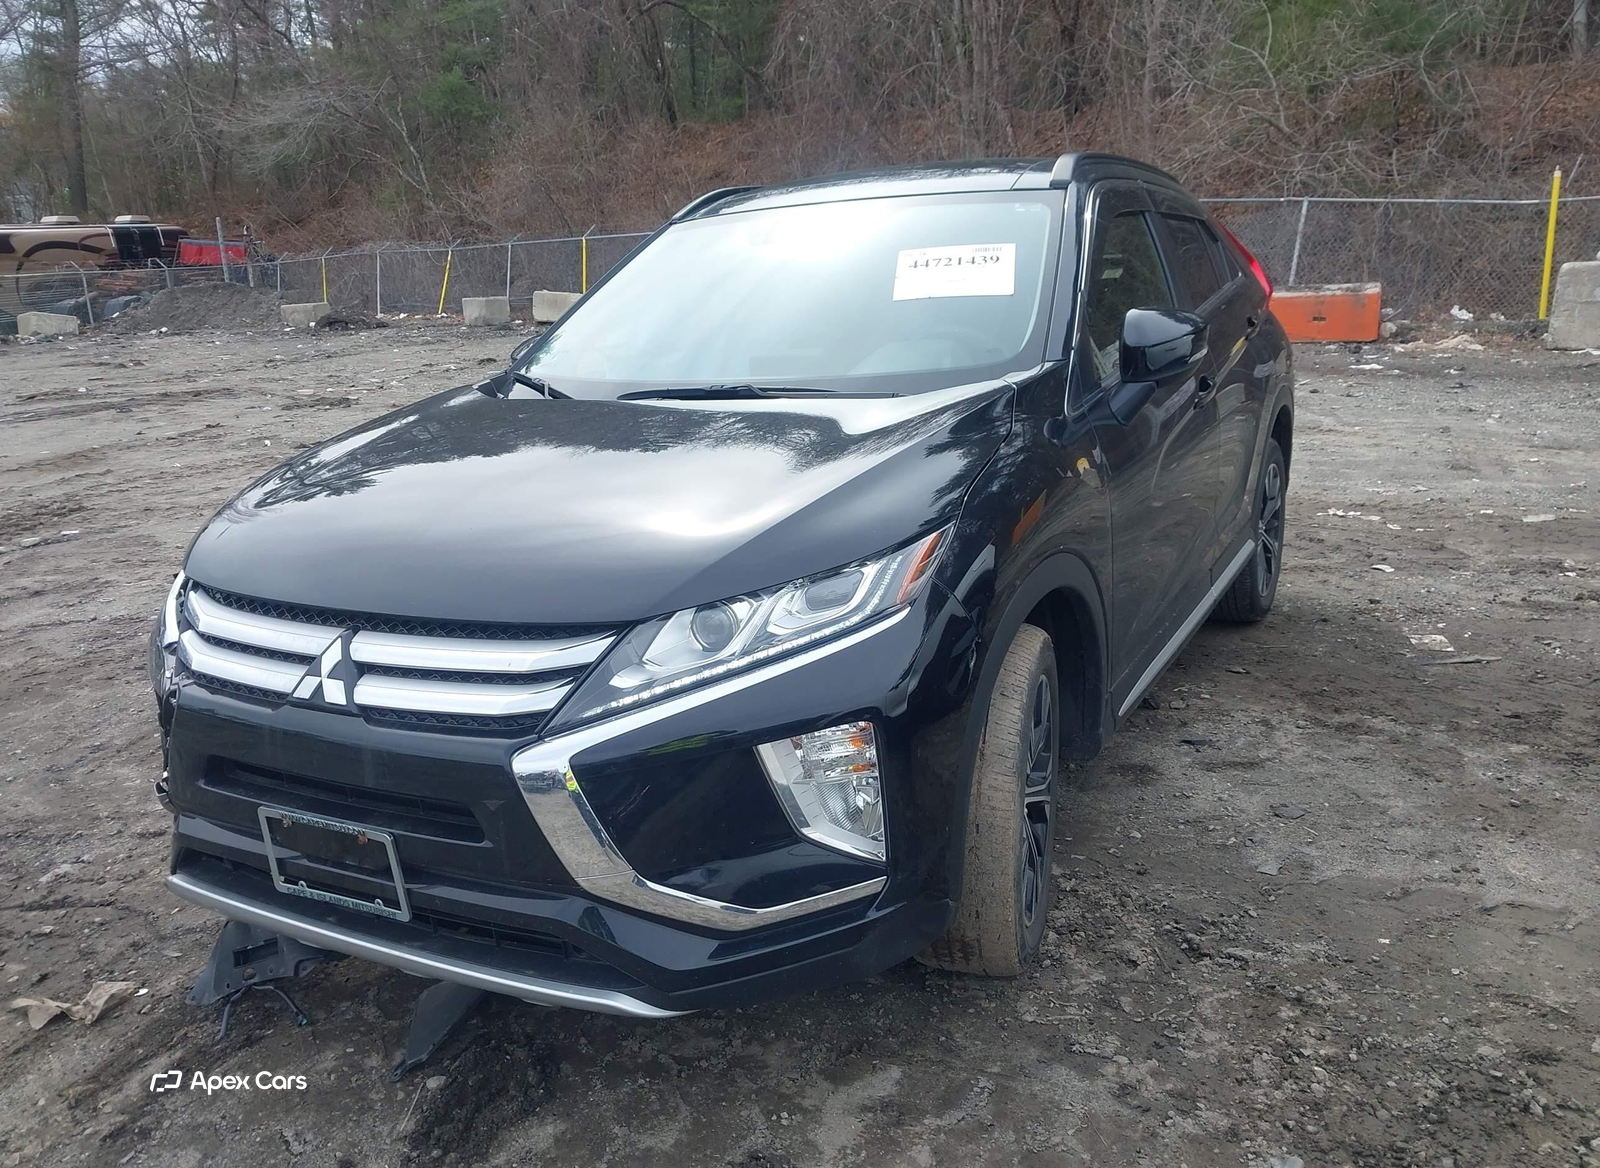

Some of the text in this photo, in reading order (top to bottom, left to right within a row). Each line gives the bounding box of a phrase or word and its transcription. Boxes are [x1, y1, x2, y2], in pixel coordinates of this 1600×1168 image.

[908, 255, 1000, 269] 44721439
[286, 886, 307, 898] CAPE
[317, 893, 351, 908] ISLANDS
[351, 901, 398, 920] MITSUBISHI
